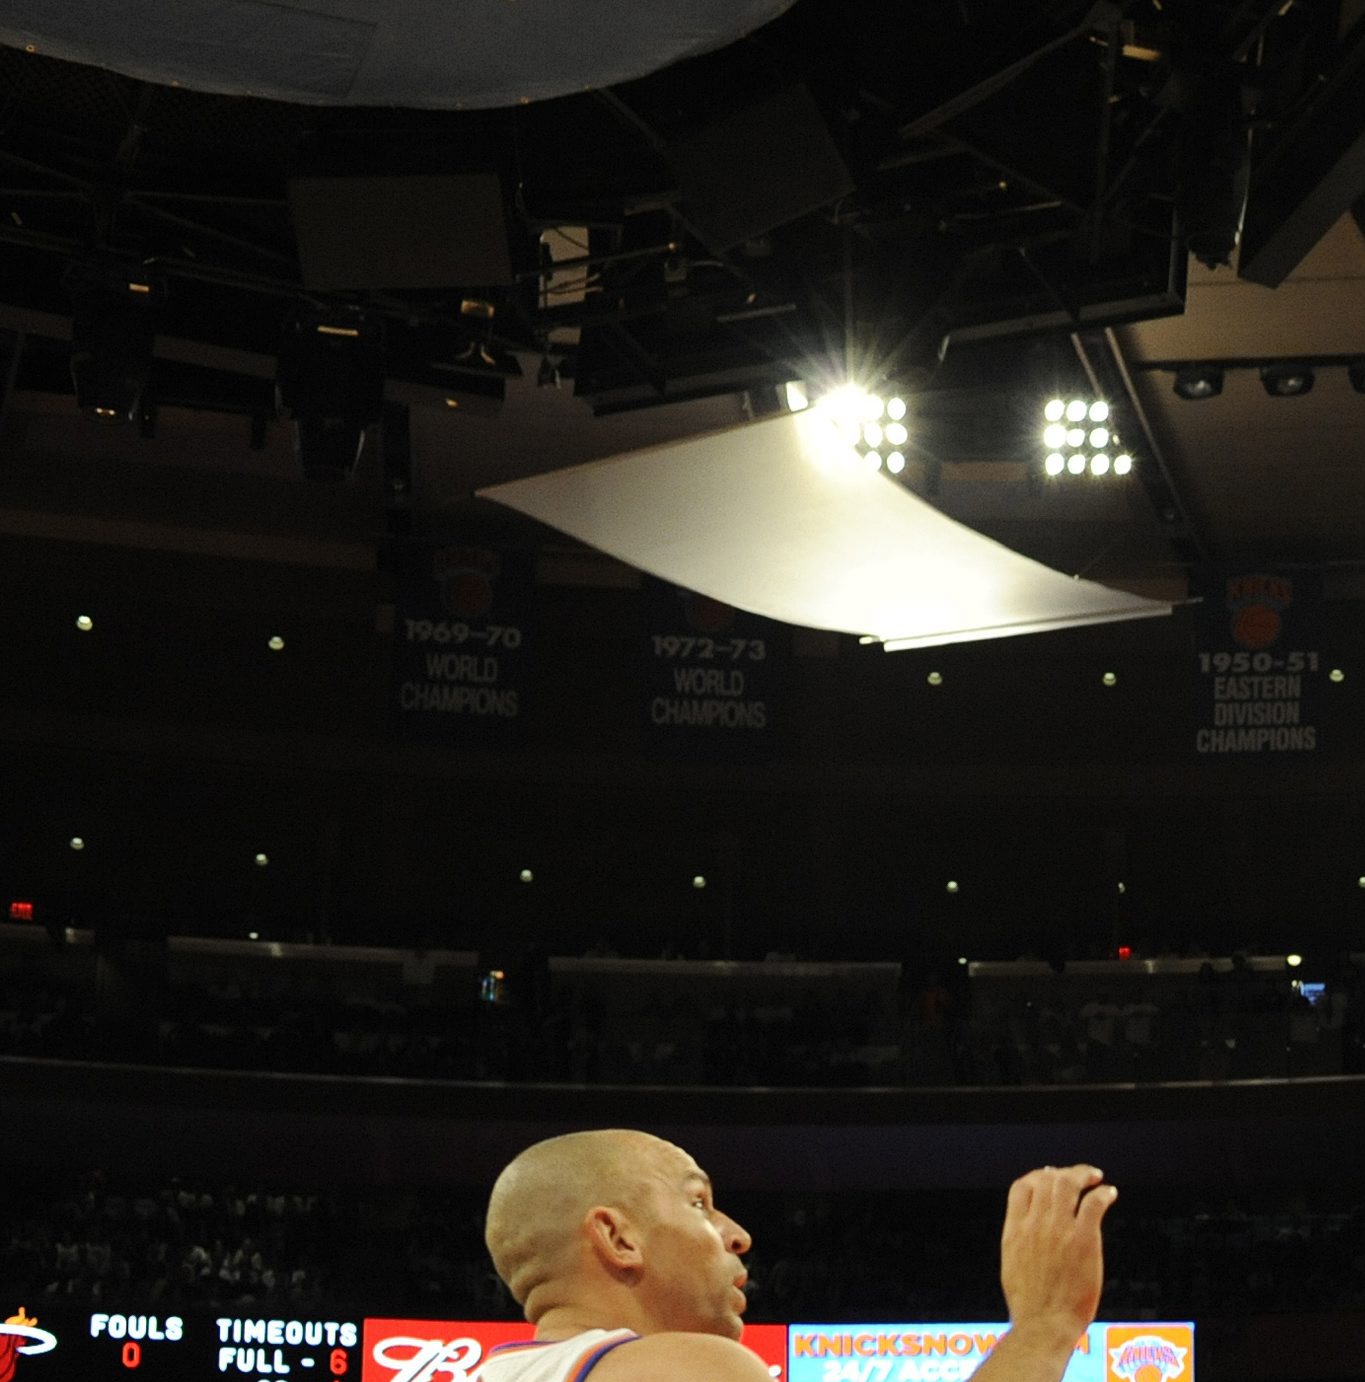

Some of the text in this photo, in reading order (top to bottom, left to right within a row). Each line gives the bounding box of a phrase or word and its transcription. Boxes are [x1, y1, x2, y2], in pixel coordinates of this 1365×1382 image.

[425, 653, 498, 683] WORLD
[1199, 651, 1319, 674] 1950-51
[673, 668, 744, 696] WORLD
[1214, 675, 1300, 701] EASTERN
[400, 681, 518, 718] CHAMPIONS
[651, 697, 766, 729] CHAMPIONS
[1214, 701, 1300, 726] DIVISION
[1196, 727, 1317, 753] CHAMPIONS
[90, 1313, 183, 1342] FOULS
[216, 1318, 357, 1347] TIMEOUTS
[121, 1342, 141, 1369] 0
[218, 1347, 290, 1374] FULL
[329, 1349, 348, 1375] 6
[898, 1360, 975, 1382] ACCE
